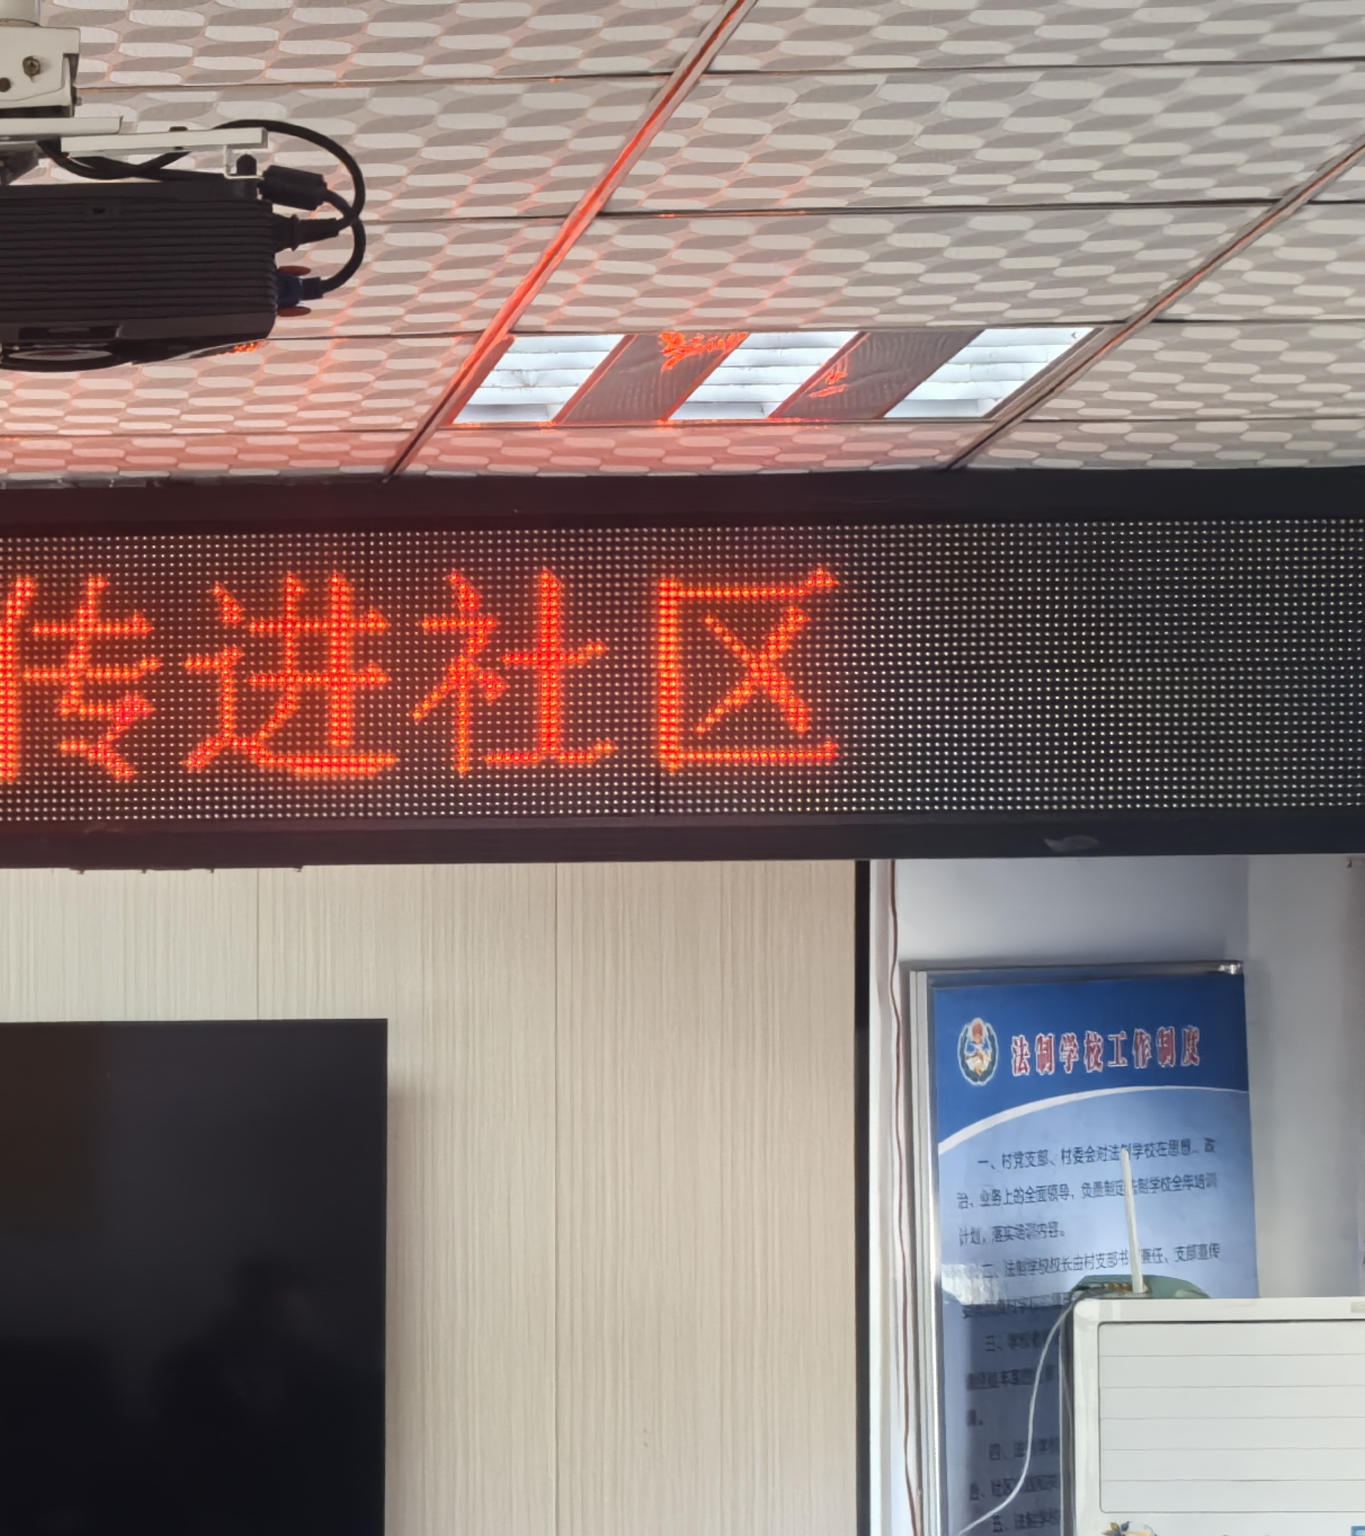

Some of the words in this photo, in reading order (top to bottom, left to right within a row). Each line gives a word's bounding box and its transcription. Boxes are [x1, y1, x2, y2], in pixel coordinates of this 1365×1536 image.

[1011, 1025, 1201, 1077] 法制学校工作制度
